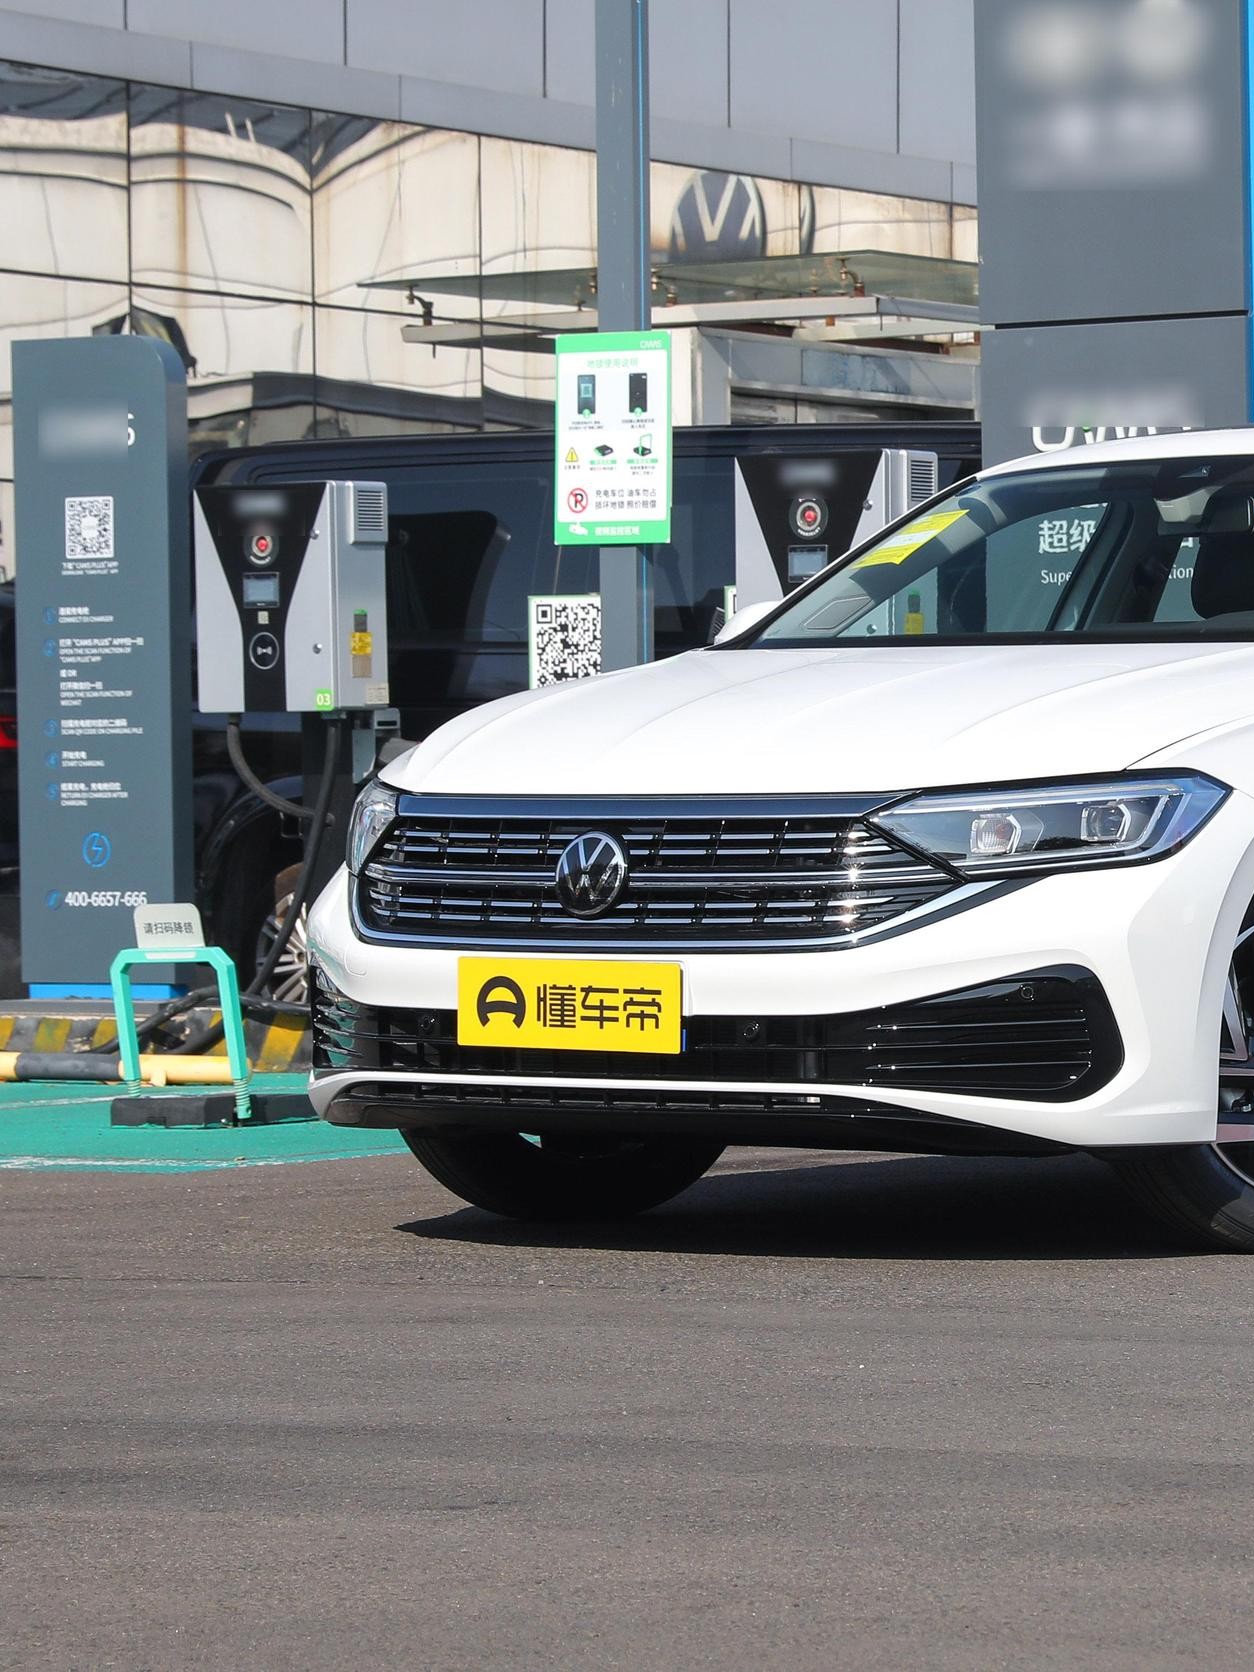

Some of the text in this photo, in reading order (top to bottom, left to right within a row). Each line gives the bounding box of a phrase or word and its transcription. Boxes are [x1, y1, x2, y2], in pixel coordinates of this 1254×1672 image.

[316, 694, 331, 706] 03
[65, 891, 147, 907] 400-6657-666
[536, 983, 662, 1032] 懂车帝
